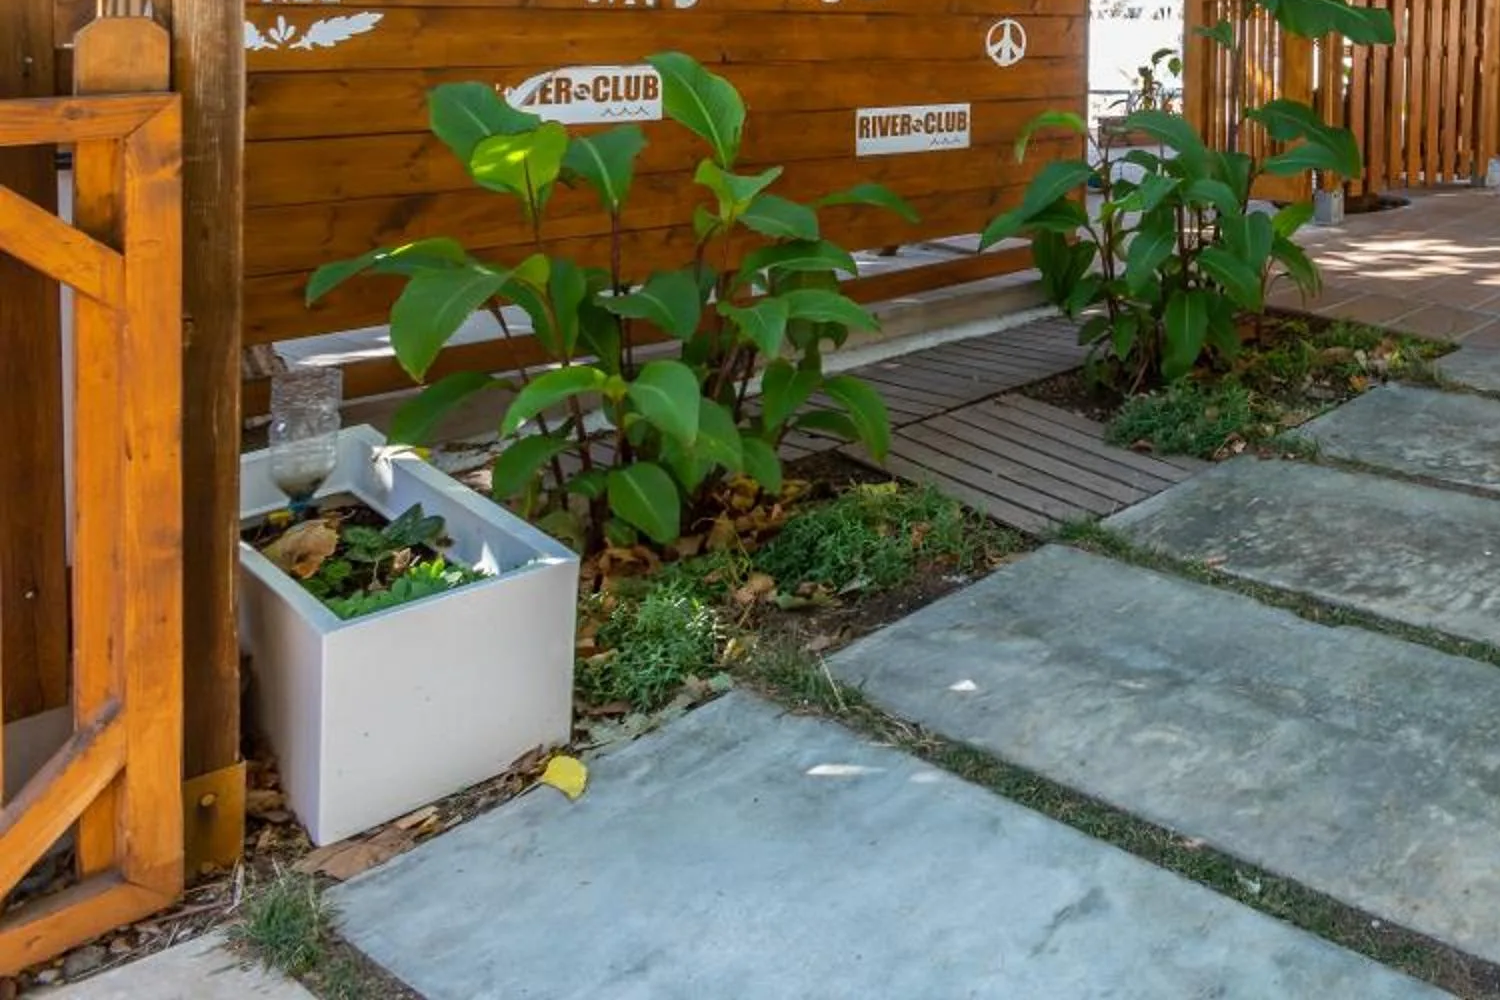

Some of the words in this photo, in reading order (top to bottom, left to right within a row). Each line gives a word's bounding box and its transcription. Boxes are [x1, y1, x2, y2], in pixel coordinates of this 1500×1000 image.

[592, 74, 659, 103] CLUB
[858, 112, 913, 139] RIVER
[923, 110, 967, 135] CLUB
